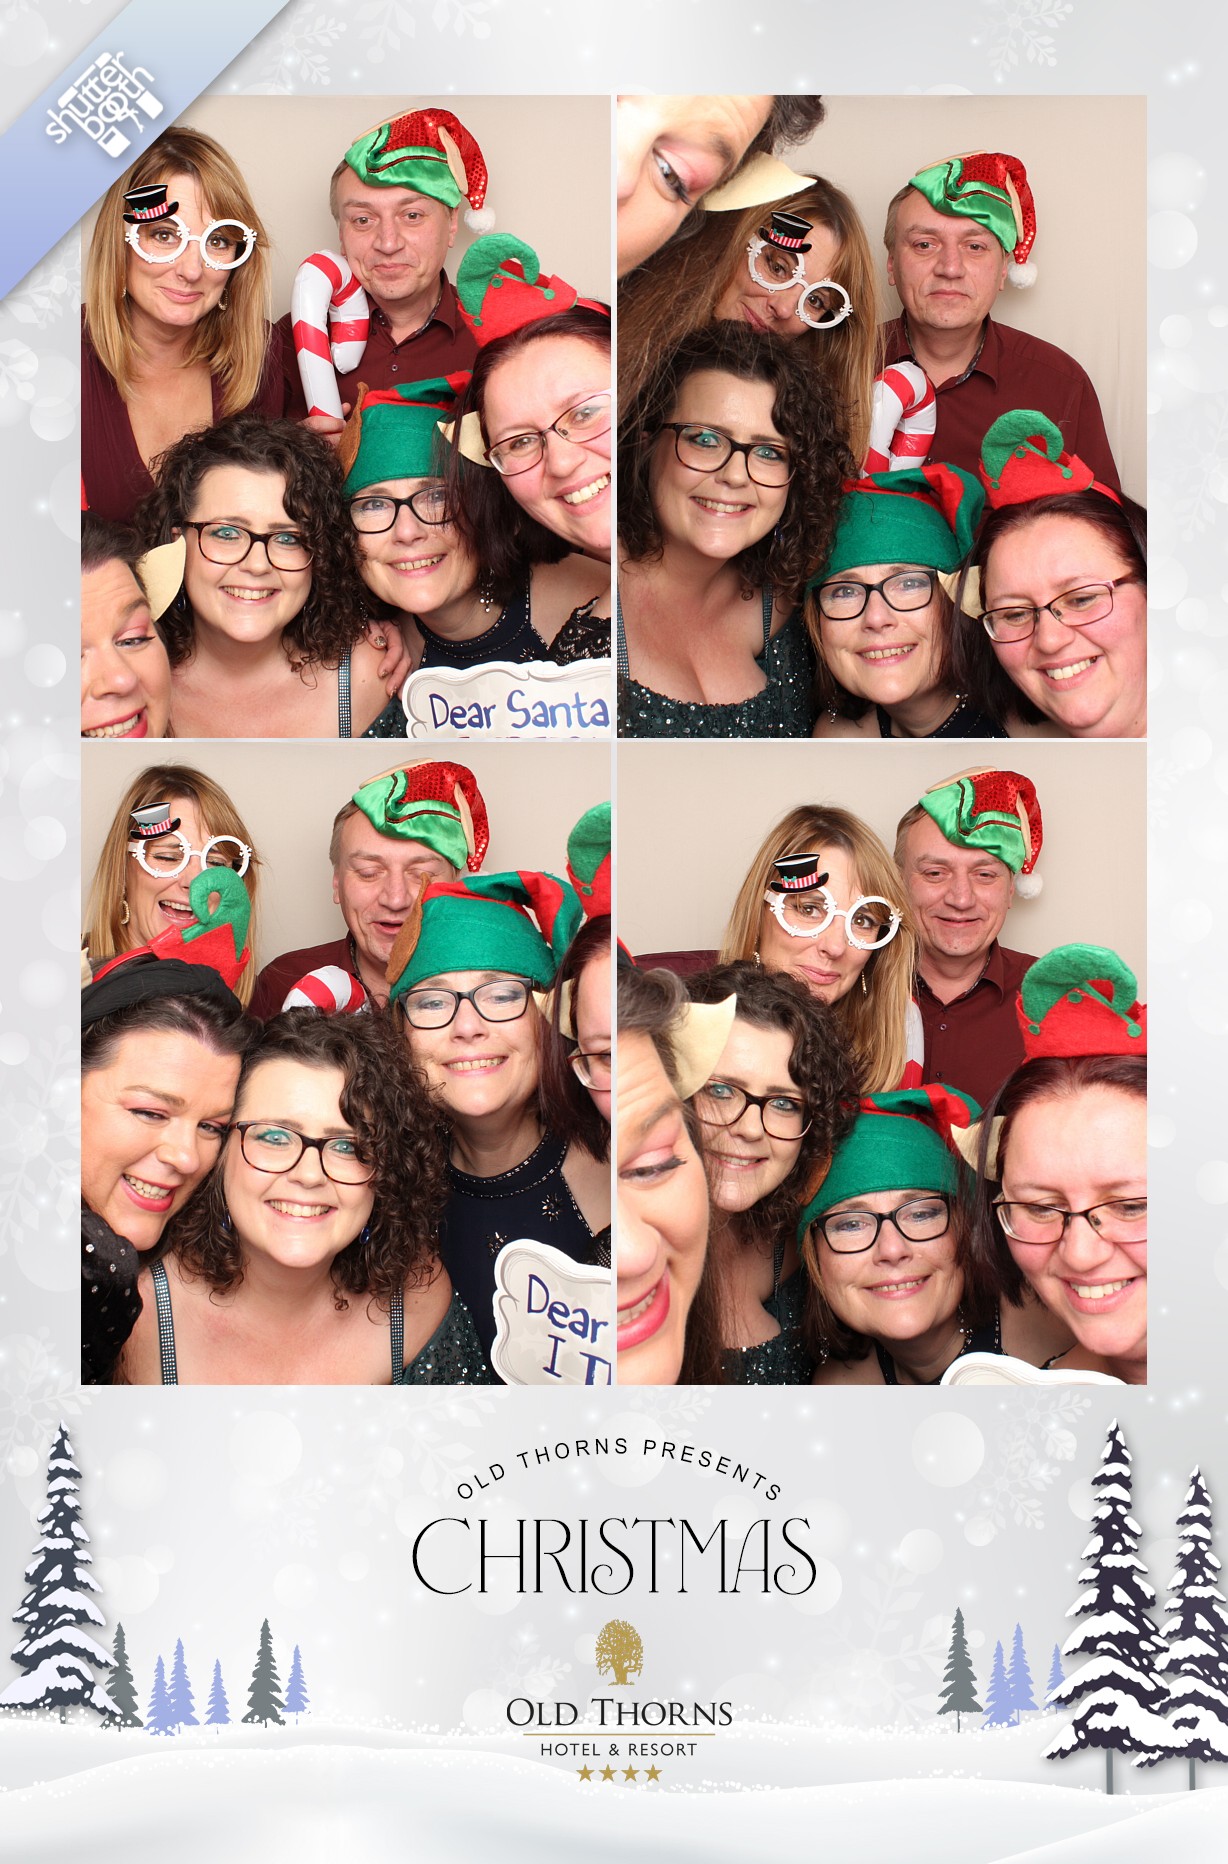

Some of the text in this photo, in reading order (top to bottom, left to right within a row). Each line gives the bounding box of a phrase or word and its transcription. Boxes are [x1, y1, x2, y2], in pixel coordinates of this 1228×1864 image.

[428, 689, 610, 729] Dear Santa
[527, 1273, 609, 1344] Dear
[542, 1334, 567, 1378] I
